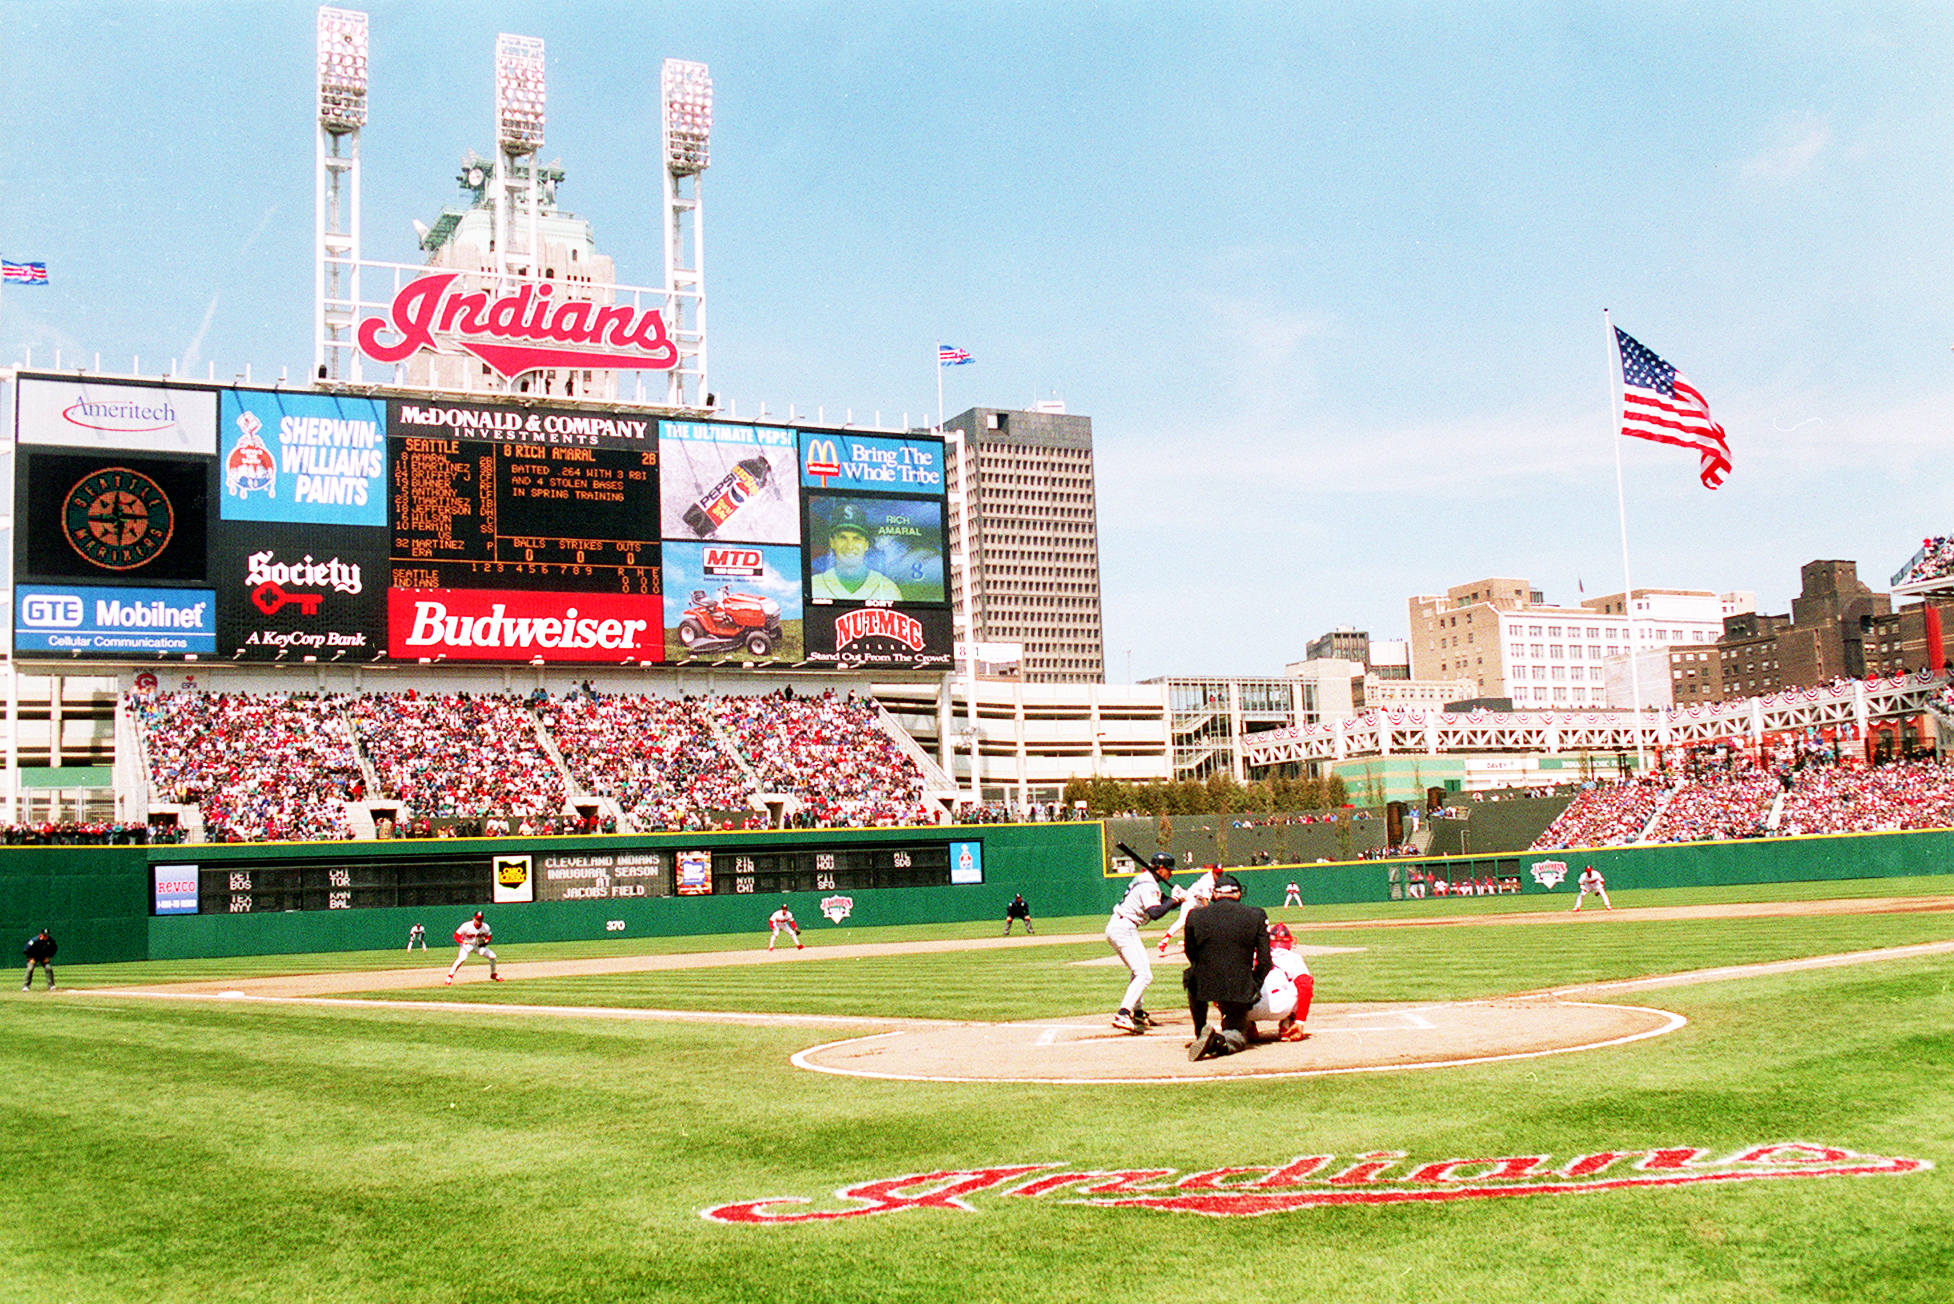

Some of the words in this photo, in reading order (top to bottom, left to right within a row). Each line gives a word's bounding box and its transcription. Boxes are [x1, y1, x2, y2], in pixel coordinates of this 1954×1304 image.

[357, 273, 678, 373] Indians
[71, 395, 176, 421] Ameritech
[400, 406, 522, 431] McDONALD
[525, 414, 542, 432] &
[543, 415, 648, 439] COMPANY
[279, 415, 384, 449] SHERWIN-
[455, 427, 599, 445] INVESTMENTS
[665, 423, 689, 438] THE
[693, 425, 754, 442] ULTIMATE
[405, 438, 460, 454] SEATTLE
[281, 445, 382, 478] WILLIAMS
[401, 452, 408, 460] 8
[411, 453, 450, 463] AMARAL
[503, 444, 512, 458] 8
[515, 445, 546, 459] RICH
[552, 447, 596, 462] AMARAL
[642, 452, 656, 466] 2B
[851, 443, 898, 468] Bring
[899, 446, 933, 465] The
[396, 460, 407, 469] 11
[411, 461, 470, 472] EMARTINEZ
[511, 464, 550, 475] BATTED
[558, 467, 580, 476] .264
[586, 468, 612, 478] WITH
[616, 470, 624, 478] 3
[628, 470, 646, 480] RBI
[842, 461, 896, 482] Whole
[897, 464, 940, 485] Tribe
[411, 470, 458, 480] GRIFFEY
[463, 471, 470, 482] J
[512, 476, 531, 486] AND
[536, 477, 544, 486] 4
[550, 478, 588, 488] STOLEN
[592, 480, 624, 490] BASES
[295, 474, 369, 506] PAINTS
[411, 479, 451, 488] BUHNER
[700, 473, 736, 508] PEPSI
[74, 476, 160, 508] SEATTLE
[401, 486, 408, 495] 5
[411, 488, 458, 497] ANTHONY
[479, 490, 492, 499] LF
[512, 487, 525, 497] IN
[531, 488, 569, 499] SPRING
[575, 490, 624, 502] TRAINING
[411, 496, 470, 506] TMARTINEZ
[481, 499, 493, 508] 1B
[396, 504, 408, 513] 18
[411, 504, 471, 516] JEFFERSON
[401, 512, 408, 521] 6
[411, 513, 452, 522] WILSON
[486, 516, 494, 525] C
[886, 515, 910, 524] RICH
[396, 521, 409, 530] 10
[412, 522, 452, 532] FERMIN
[480, 524, 494, 534] SS
[878, 526, 922, 536] AMARAL
[74, 528, 163, 561] MARINERS
[395, 538, 409, 548] 32
[412, 539, 464, 550] MARTINEZ
[486, 541, 494, 550] P
[513, 539, 546, 549] BALLS
[559, 540, 602, 551] STRIKES
[616, 542, 641, 552] OUTS
[412, 548, 432, 556] ERA
[525, 548, 534, 562] 0
[576, 550, 584, 564] 0
[626, 552, 634, 565] 0
[706, 550, 760, 566] MTD
[244, 550, 363, 595] Society
[392, 568, 439, 579] SEATTLE
[622, 576, 629, 585] 0
[641, 577, 648, 586] 0
[652, 577, 659, 586] 0
[472, 564, 476, 572] 1
[484, 564, 490, 572] 2
[497, 564, 504, 572] 3
[516, 564, 522, 573] 4
[528, 565, 536, 574] 5
[541, 566, 548, 574] 6
[560, 566, 567, 574] 7
[572, 566, 580, 575] 8
[585, 566, 592, 576] 9
[618, 568, 624, 576] R
[637, 568, 644, 576] H
[652, 568, 658, 578] E
[912, 562, 925, 582] 8
[393, 578, 440, 588] INDIANS
[622, 584, 630, 593] 0
[641, 585, 648, 594] 0
[653, 586, 660, 594] 0
[27, 600, 79, 621] GTE
[96, 600, 204, 629] Mobilnet
[406, 601, 647, 649] Budweiser
[836, 608, 926, 652] NUTMEG
[48, 634, 92, 647] Cellular
[94, 636, 188, 648] Communications
[245, 631, 260, 644] A
[262, 631, 326, 648] KeyCorp
[326, 632, 367, 646] Bank
[810, 652, 840, 661] Stand
[842, 652, 862, 661] Out
[864, 653, 891, 662] From
[892, 654, 912, 662] The
[544, 857, 614, 868] CLEVELAND
[617, 855, 660, 866] INDIANS
[816, 861, 835, 870] HOU
[894, 859, 912, 868] SDG
[230, 870, 250, 880] DET
[329, 868, 348, 877] CHI
[547, 868, 610, 880] INAUGURAL
[614, 866, 658, 877] SEASON
[736, 864, 754, 874] CIN
[230, 880, 252, 890] BOS
[330, 877, 350, 886] TOR
[596, 878, 610, 888] AT
[817, 880, 835, 890] SFO
[330, 890, 351, 900] KAN
[563, 887, 607, 899] JACOBS
[612, 884, 645, 896] FIELD
[736, 884, 754, 894] CHI
[230, 894, 252, 904] TEX
[330, 899, 350, 908] BAL
[230, 902, 252, 912] NYY
[606, 920, 626, 931] 370
[701, 1142, 1934, 1224] Indians
